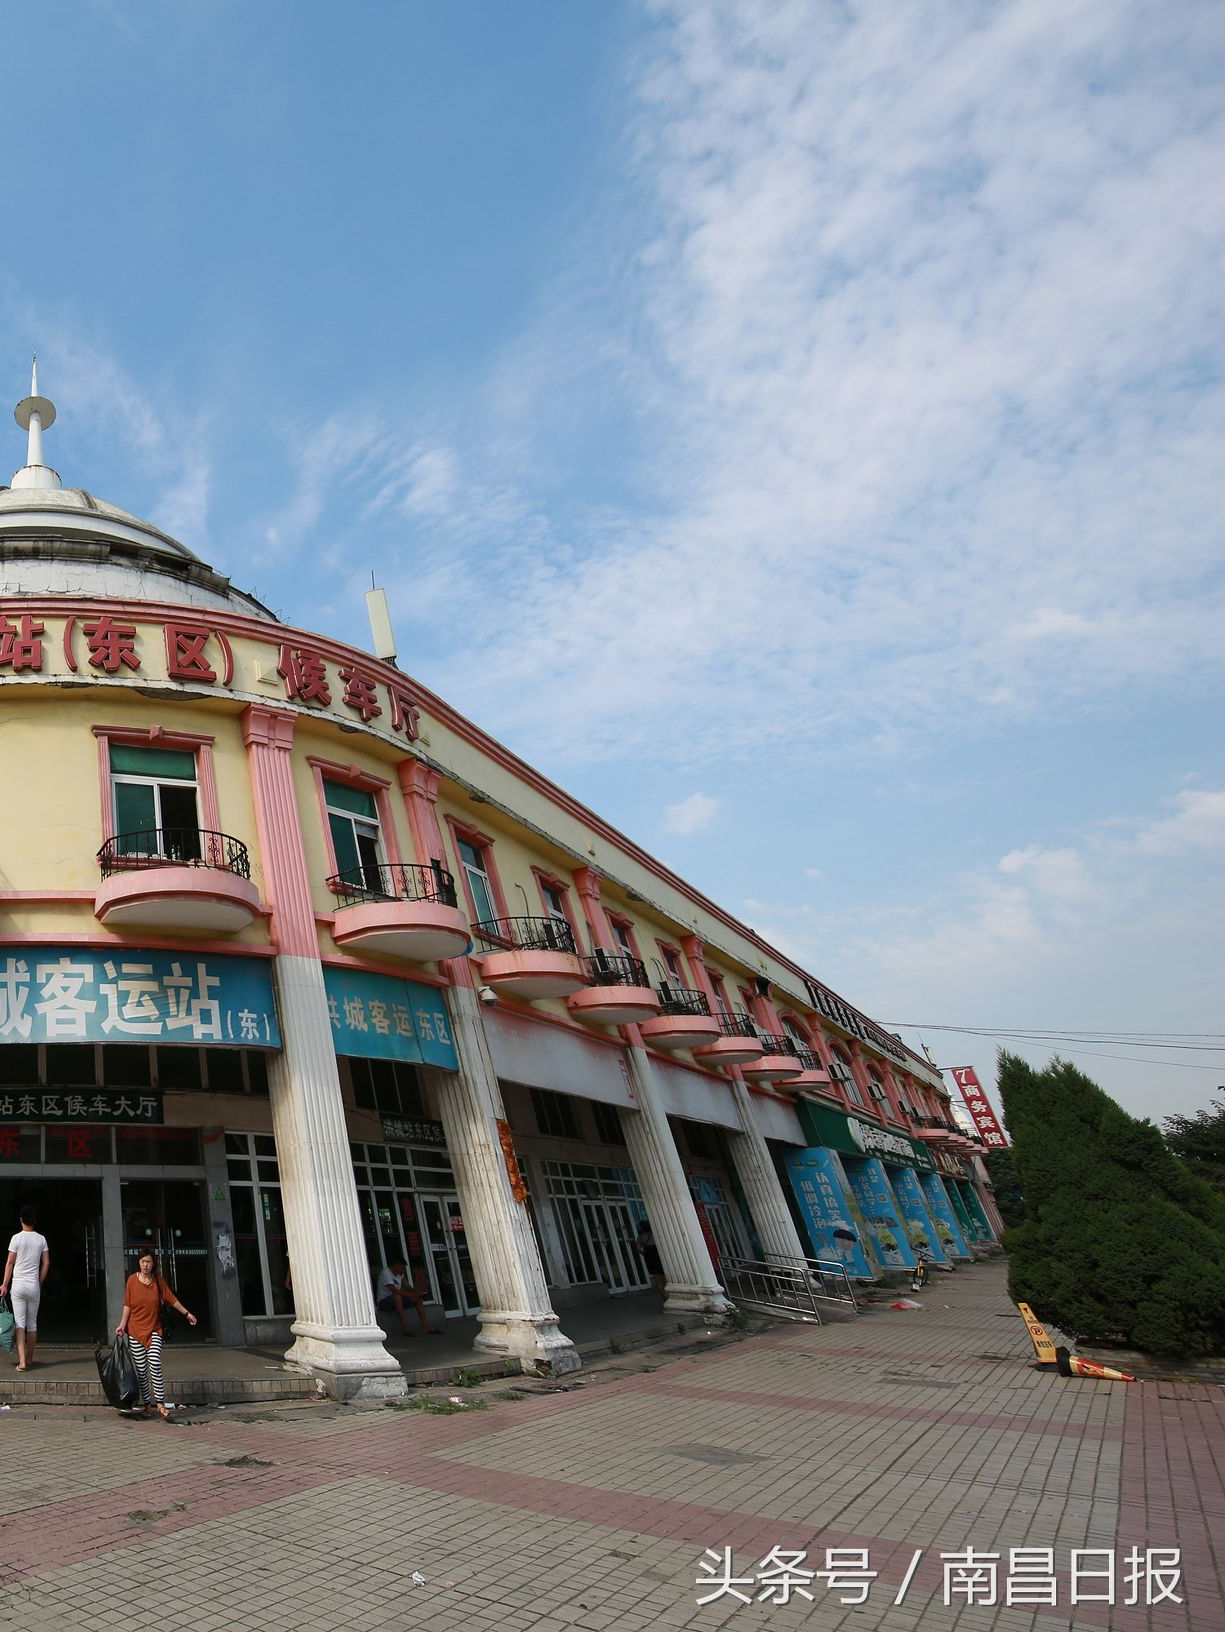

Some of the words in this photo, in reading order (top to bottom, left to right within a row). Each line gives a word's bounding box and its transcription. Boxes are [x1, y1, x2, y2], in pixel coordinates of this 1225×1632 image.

[383, 1119, 446, 1142] 洪城站东区候
